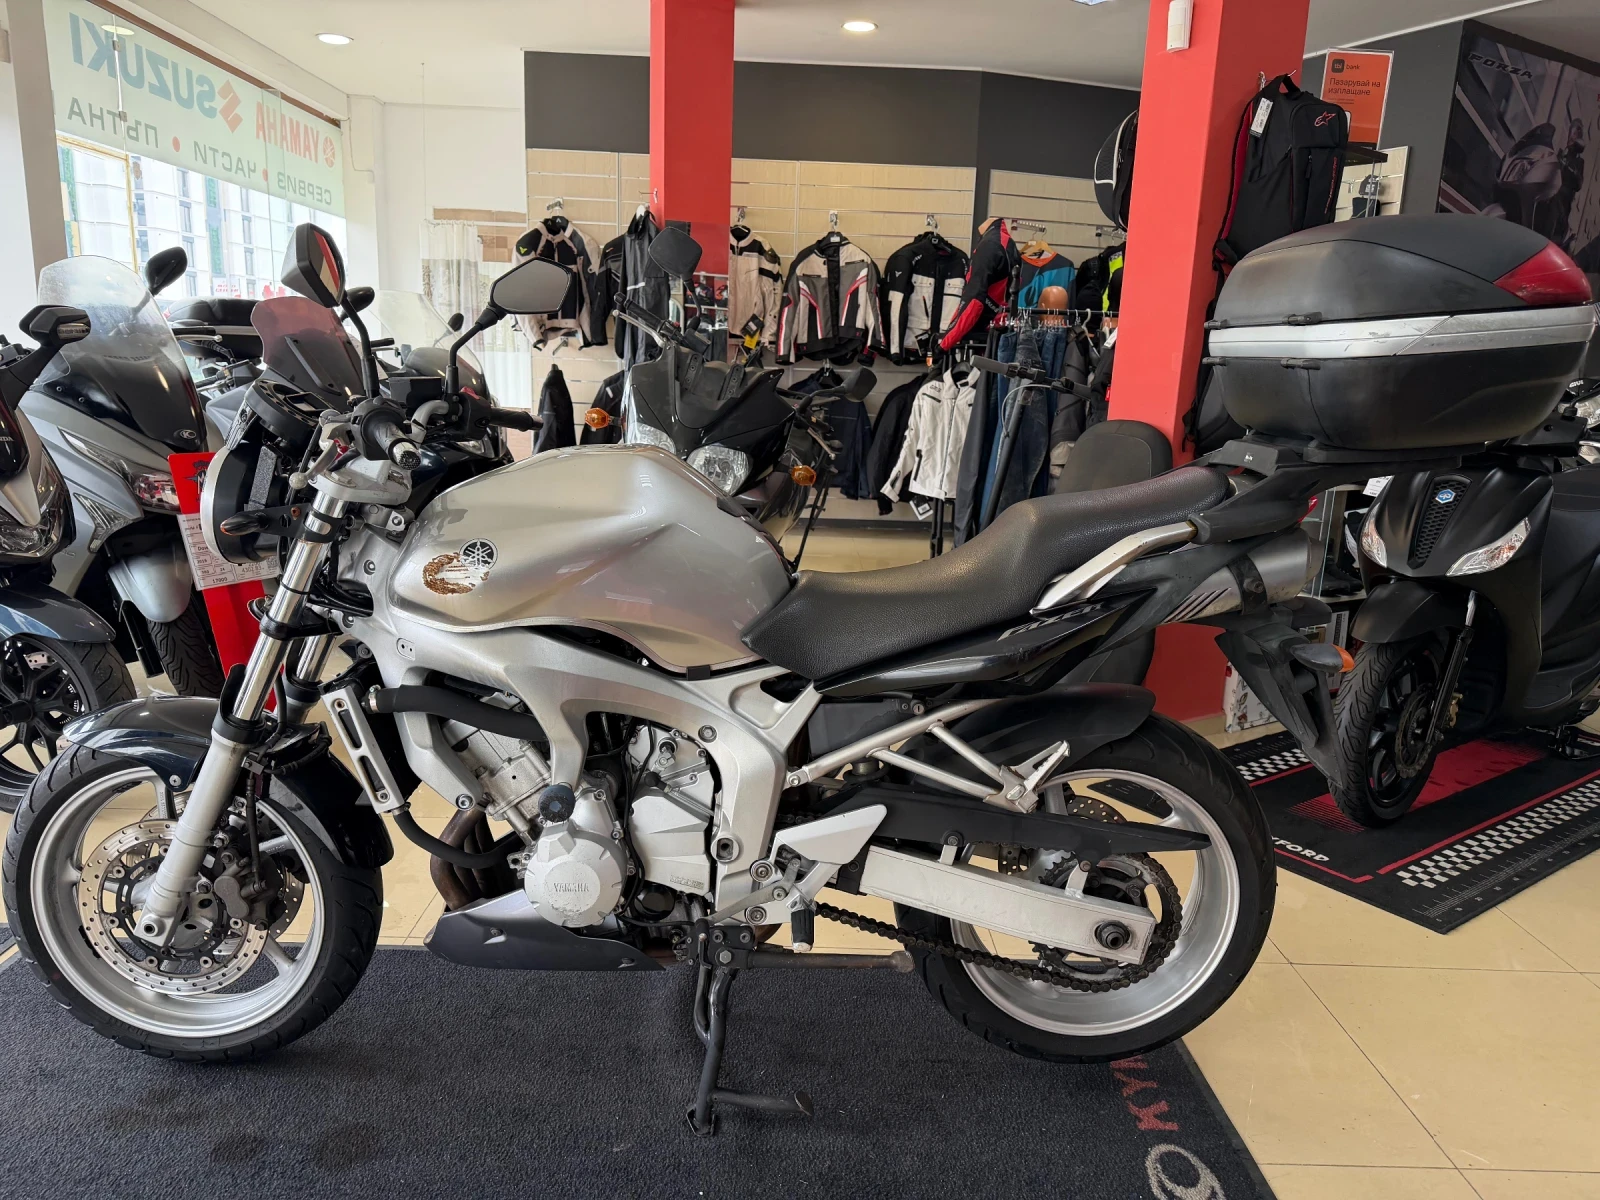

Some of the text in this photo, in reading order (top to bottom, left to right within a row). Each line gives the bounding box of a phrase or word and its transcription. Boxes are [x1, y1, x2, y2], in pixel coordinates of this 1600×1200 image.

[1468, 53, 1533, 79] FORZA
[1329, 77, 1370, 88] Пазарувай
[1327, 87, 1371, 96] изплащане
[553, 882, 590, 893] YAMAHA
